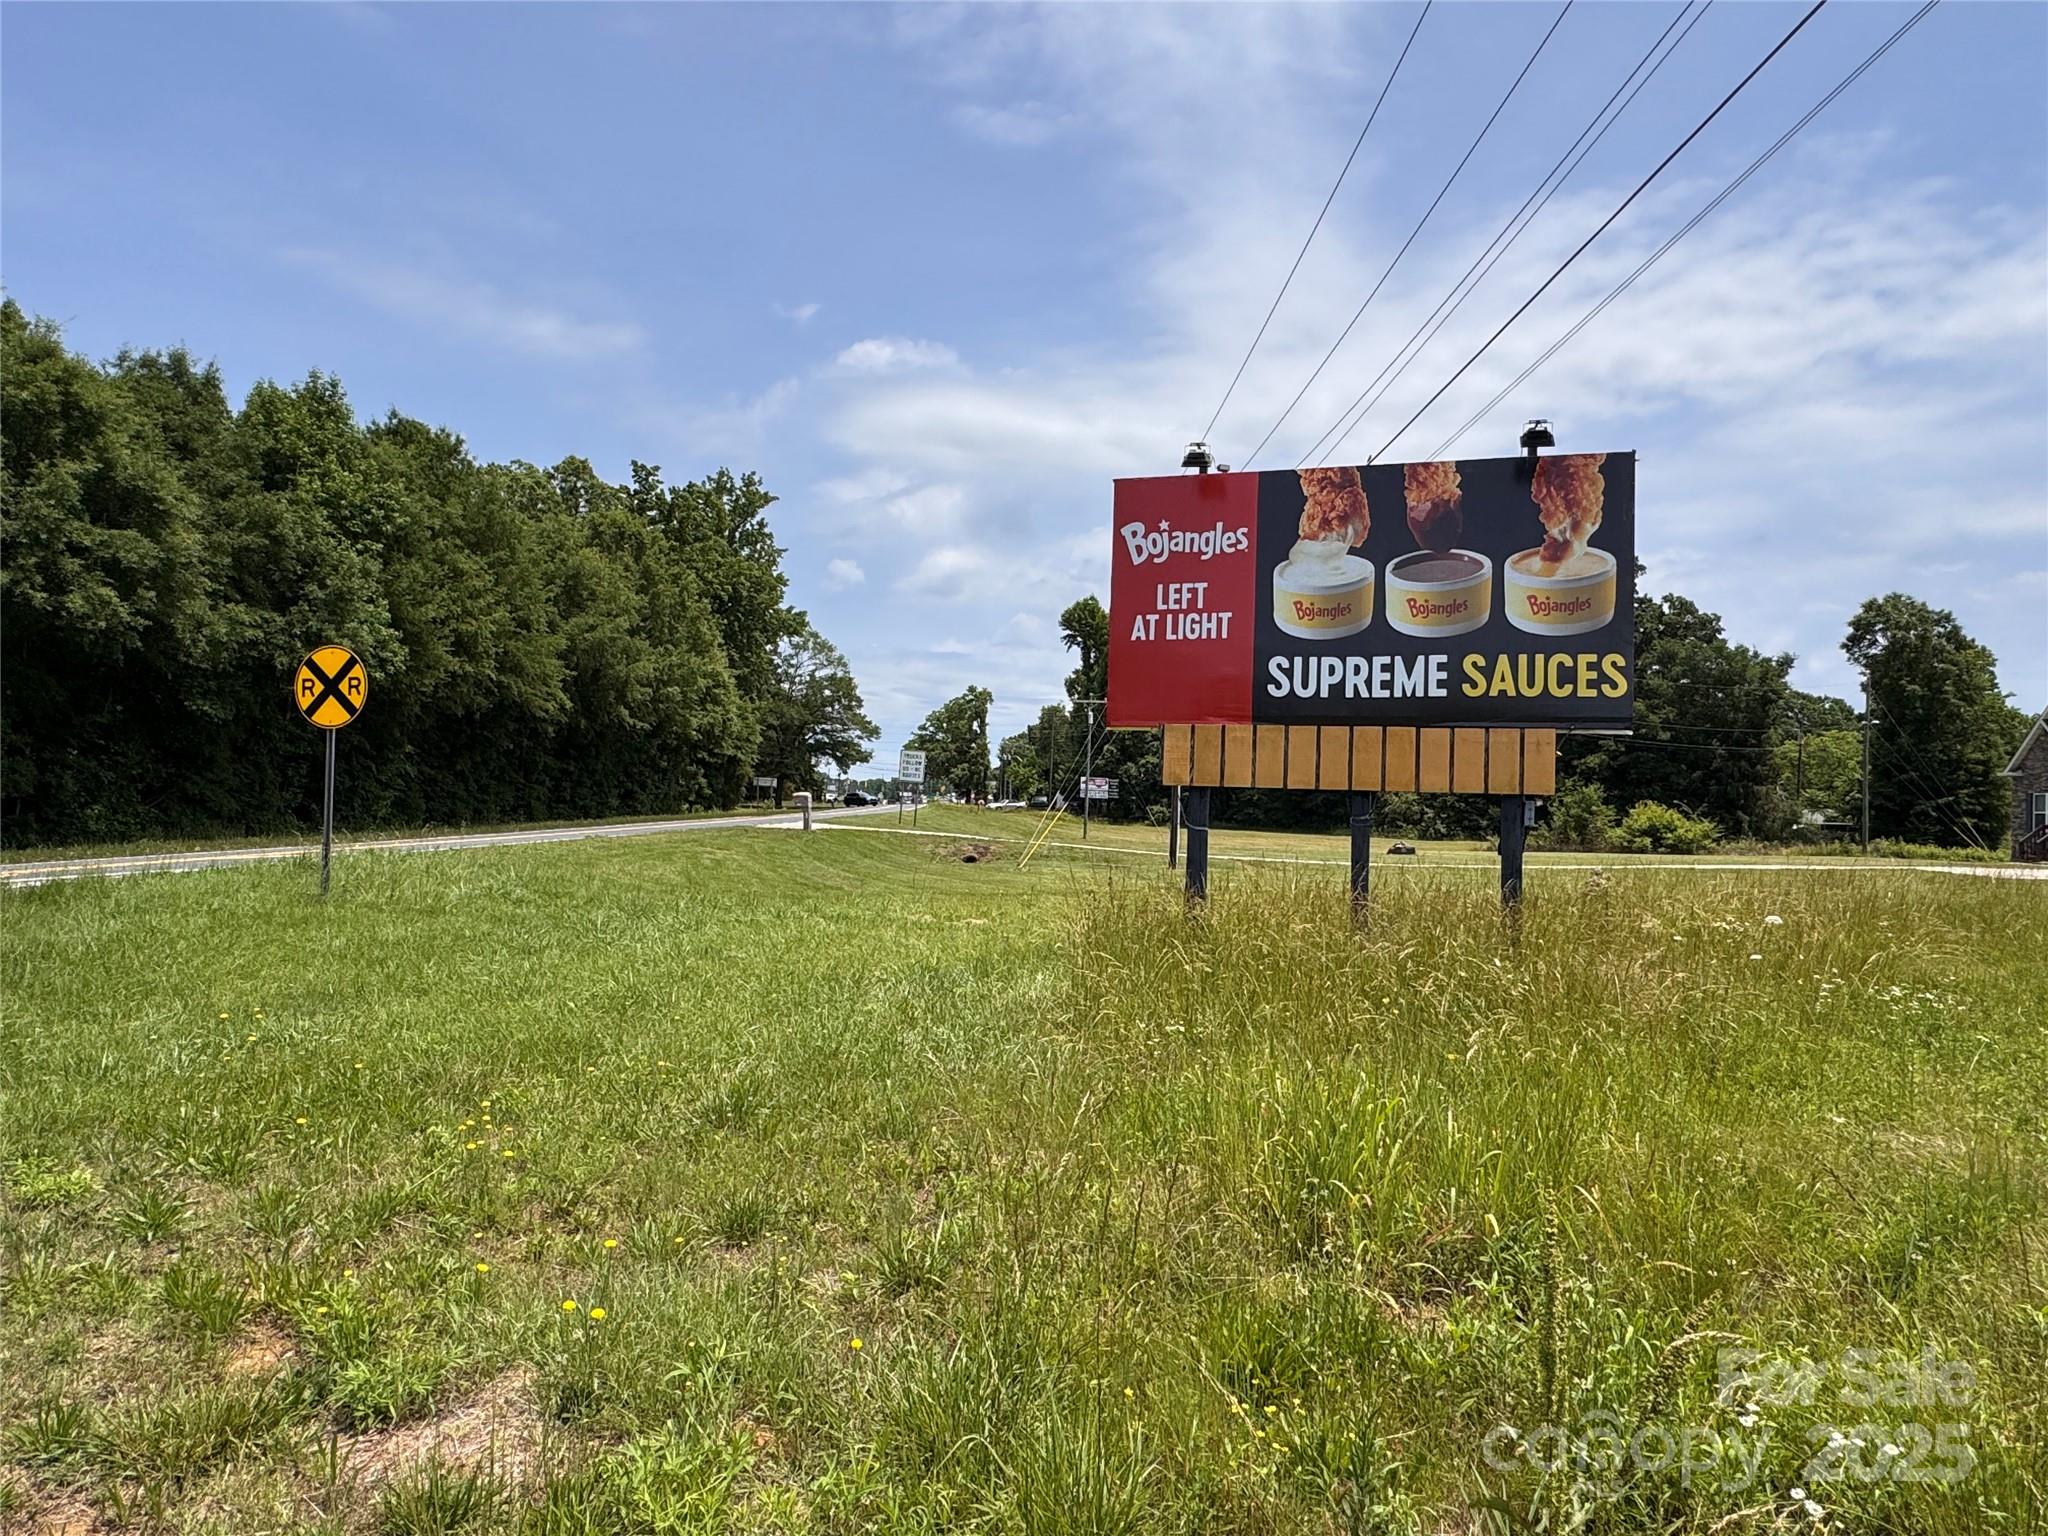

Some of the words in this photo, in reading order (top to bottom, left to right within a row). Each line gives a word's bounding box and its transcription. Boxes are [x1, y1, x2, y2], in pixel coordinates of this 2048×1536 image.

[1120, 519, 1249, 566] Bojangles
[1157, 582, 1209, 610] LEFT
[1406, 597, 1469, 619] Bojangles
[1526, 594, 1592, 616] Bojangles
[1293, 600, 1352, 621] Bojangles
[1131, 614, 1160, 641] AT
[1165, 612, 1232, 640] LIGHT
[302, 678, 316, 697] R
[348, 677, 361, 696] R
[1267, 654, 1448, 698] SUPREME
[1461, 653, 1628, 698] SAUCES
